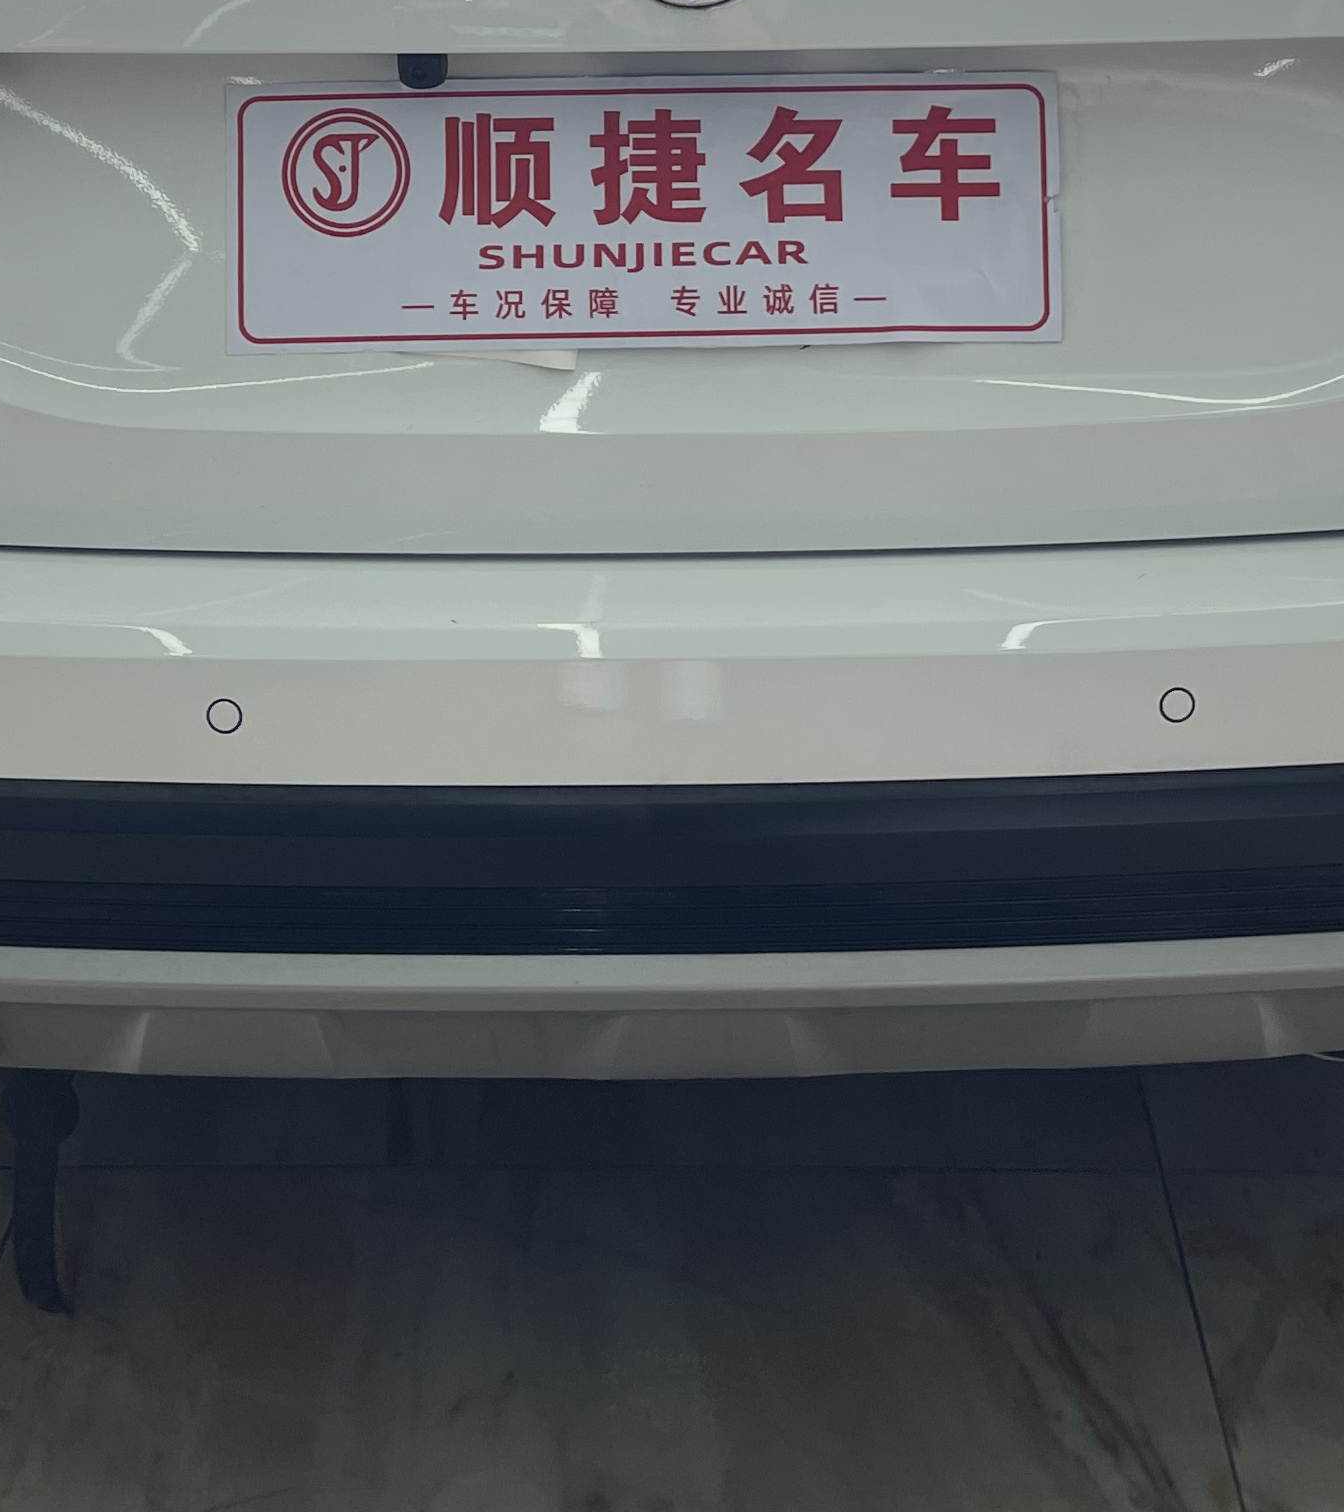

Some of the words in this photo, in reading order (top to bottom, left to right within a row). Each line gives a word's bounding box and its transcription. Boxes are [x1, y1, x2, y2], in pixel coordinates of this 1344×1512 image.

[437, 105, 1001, 230] 顺捷名车
[478, 239, 810, 274] SHUNJIECAR
